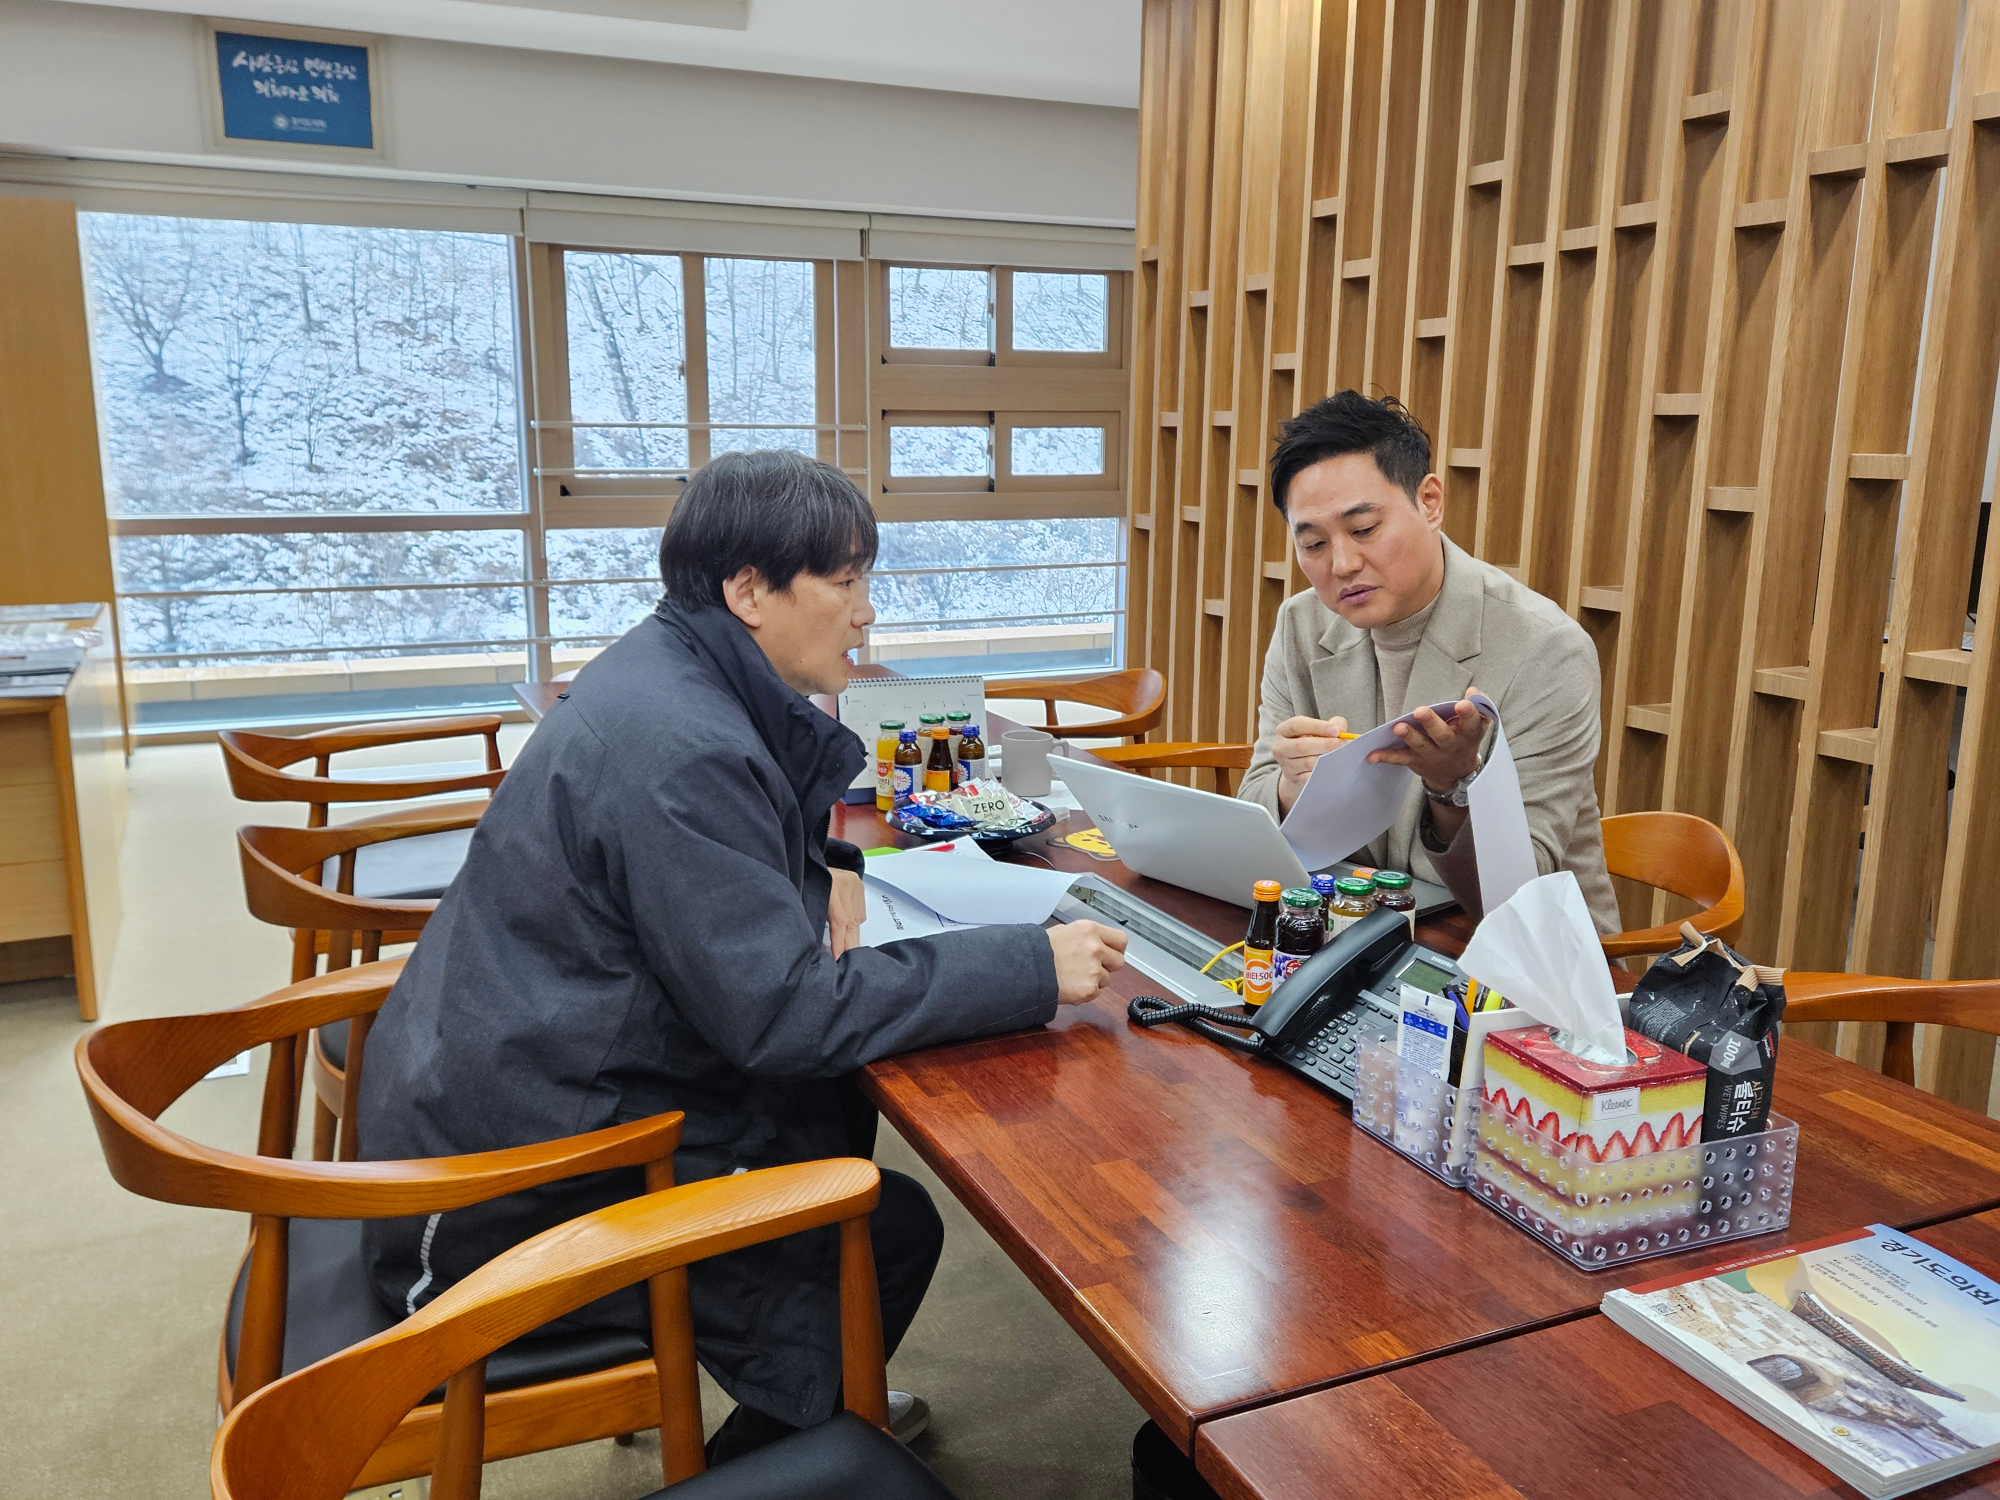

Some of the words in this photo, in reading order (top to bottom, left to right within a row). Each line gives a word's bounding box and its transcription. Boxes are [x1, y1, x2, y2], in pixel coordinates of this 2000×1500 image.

[973, 799, 1005, 814] ZERO
[1430, 955, 1454, 969] SAMSUNG
[1722, 1084, 1733, 1102] WET
[1748, 1080, 1764, 1119] 시그니처
[1601, 1098, 1634, 1112] Kleenex
[1717, 1103, 1729, 1129] WIPES
[1726, 1080, 1753, 1133] 물티슈
[1881, 1239, 2000, 1306] 경기도의회
